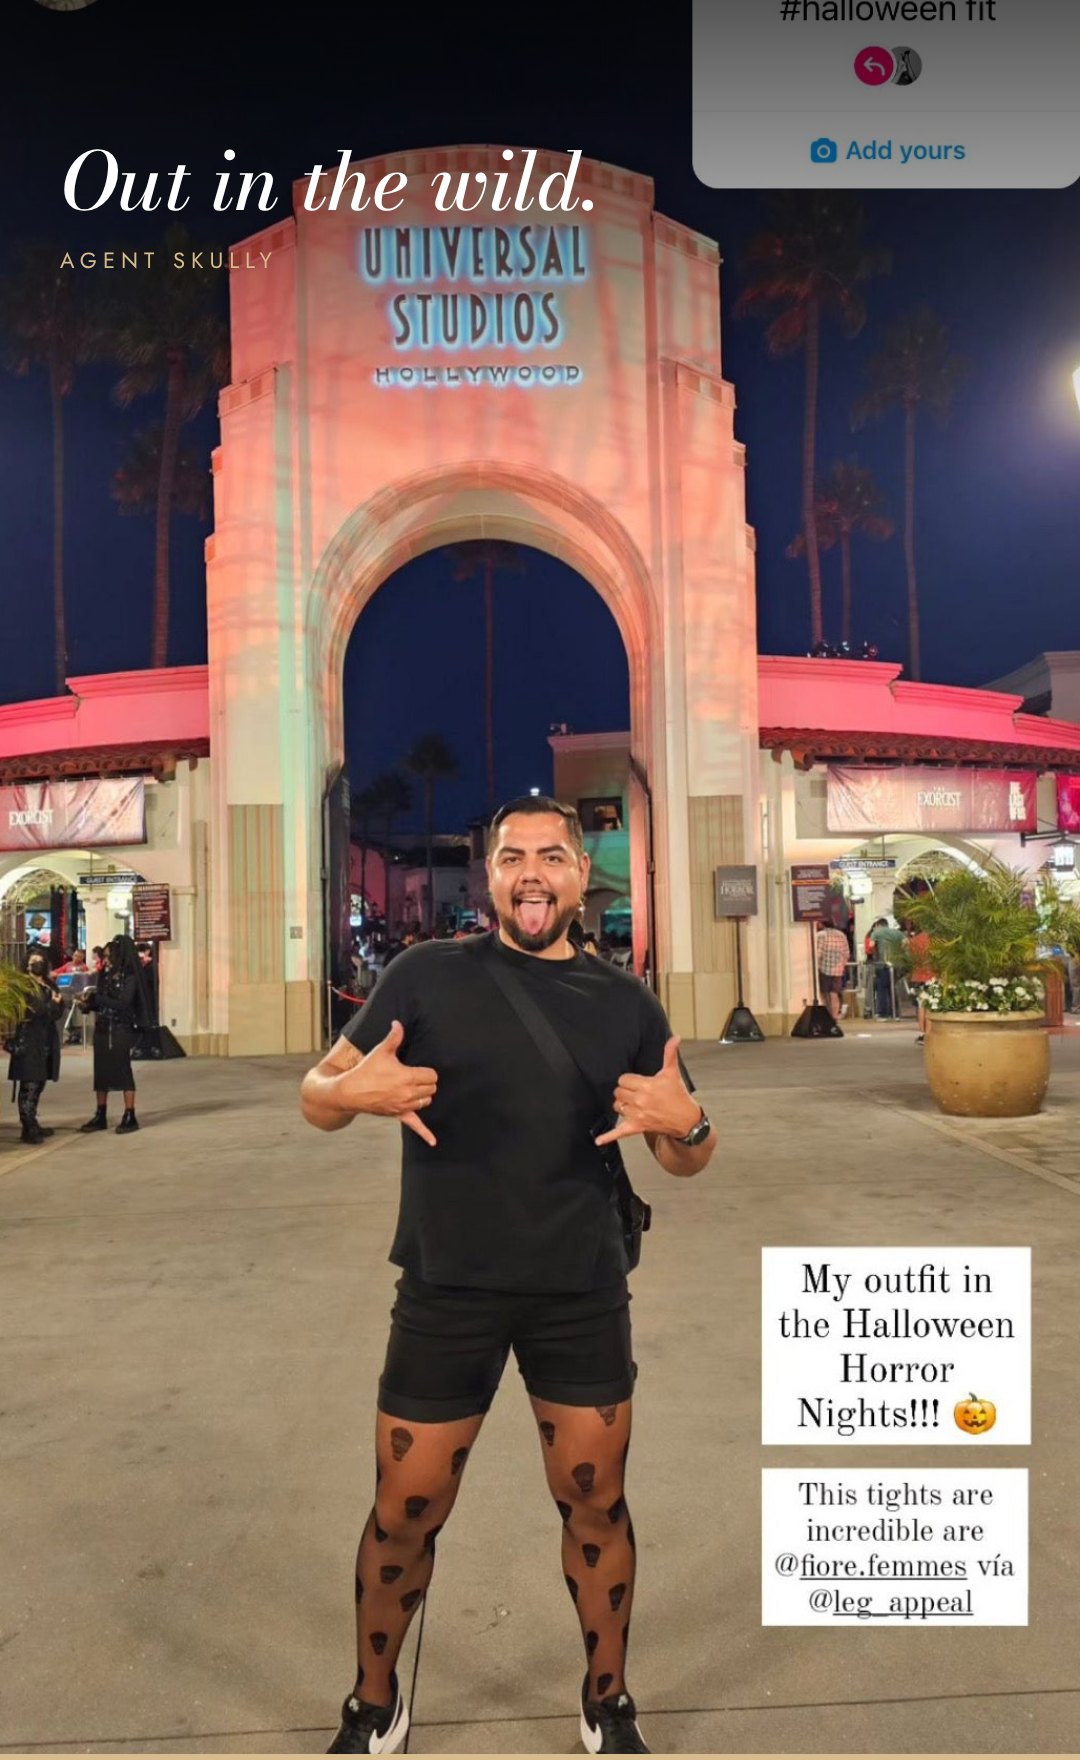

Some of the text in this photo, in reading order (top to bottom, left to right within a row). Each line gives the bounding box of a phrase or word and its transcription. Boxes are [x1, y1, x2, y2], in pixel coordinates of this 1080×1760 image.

[364, 225, 586, 279] UNIVERSAL
[393, 291, 559, 346] STUDIOS
[375, 365, 580, 383] HOLLYWOOD
[916, 791, 962, 808] EXORCIST
